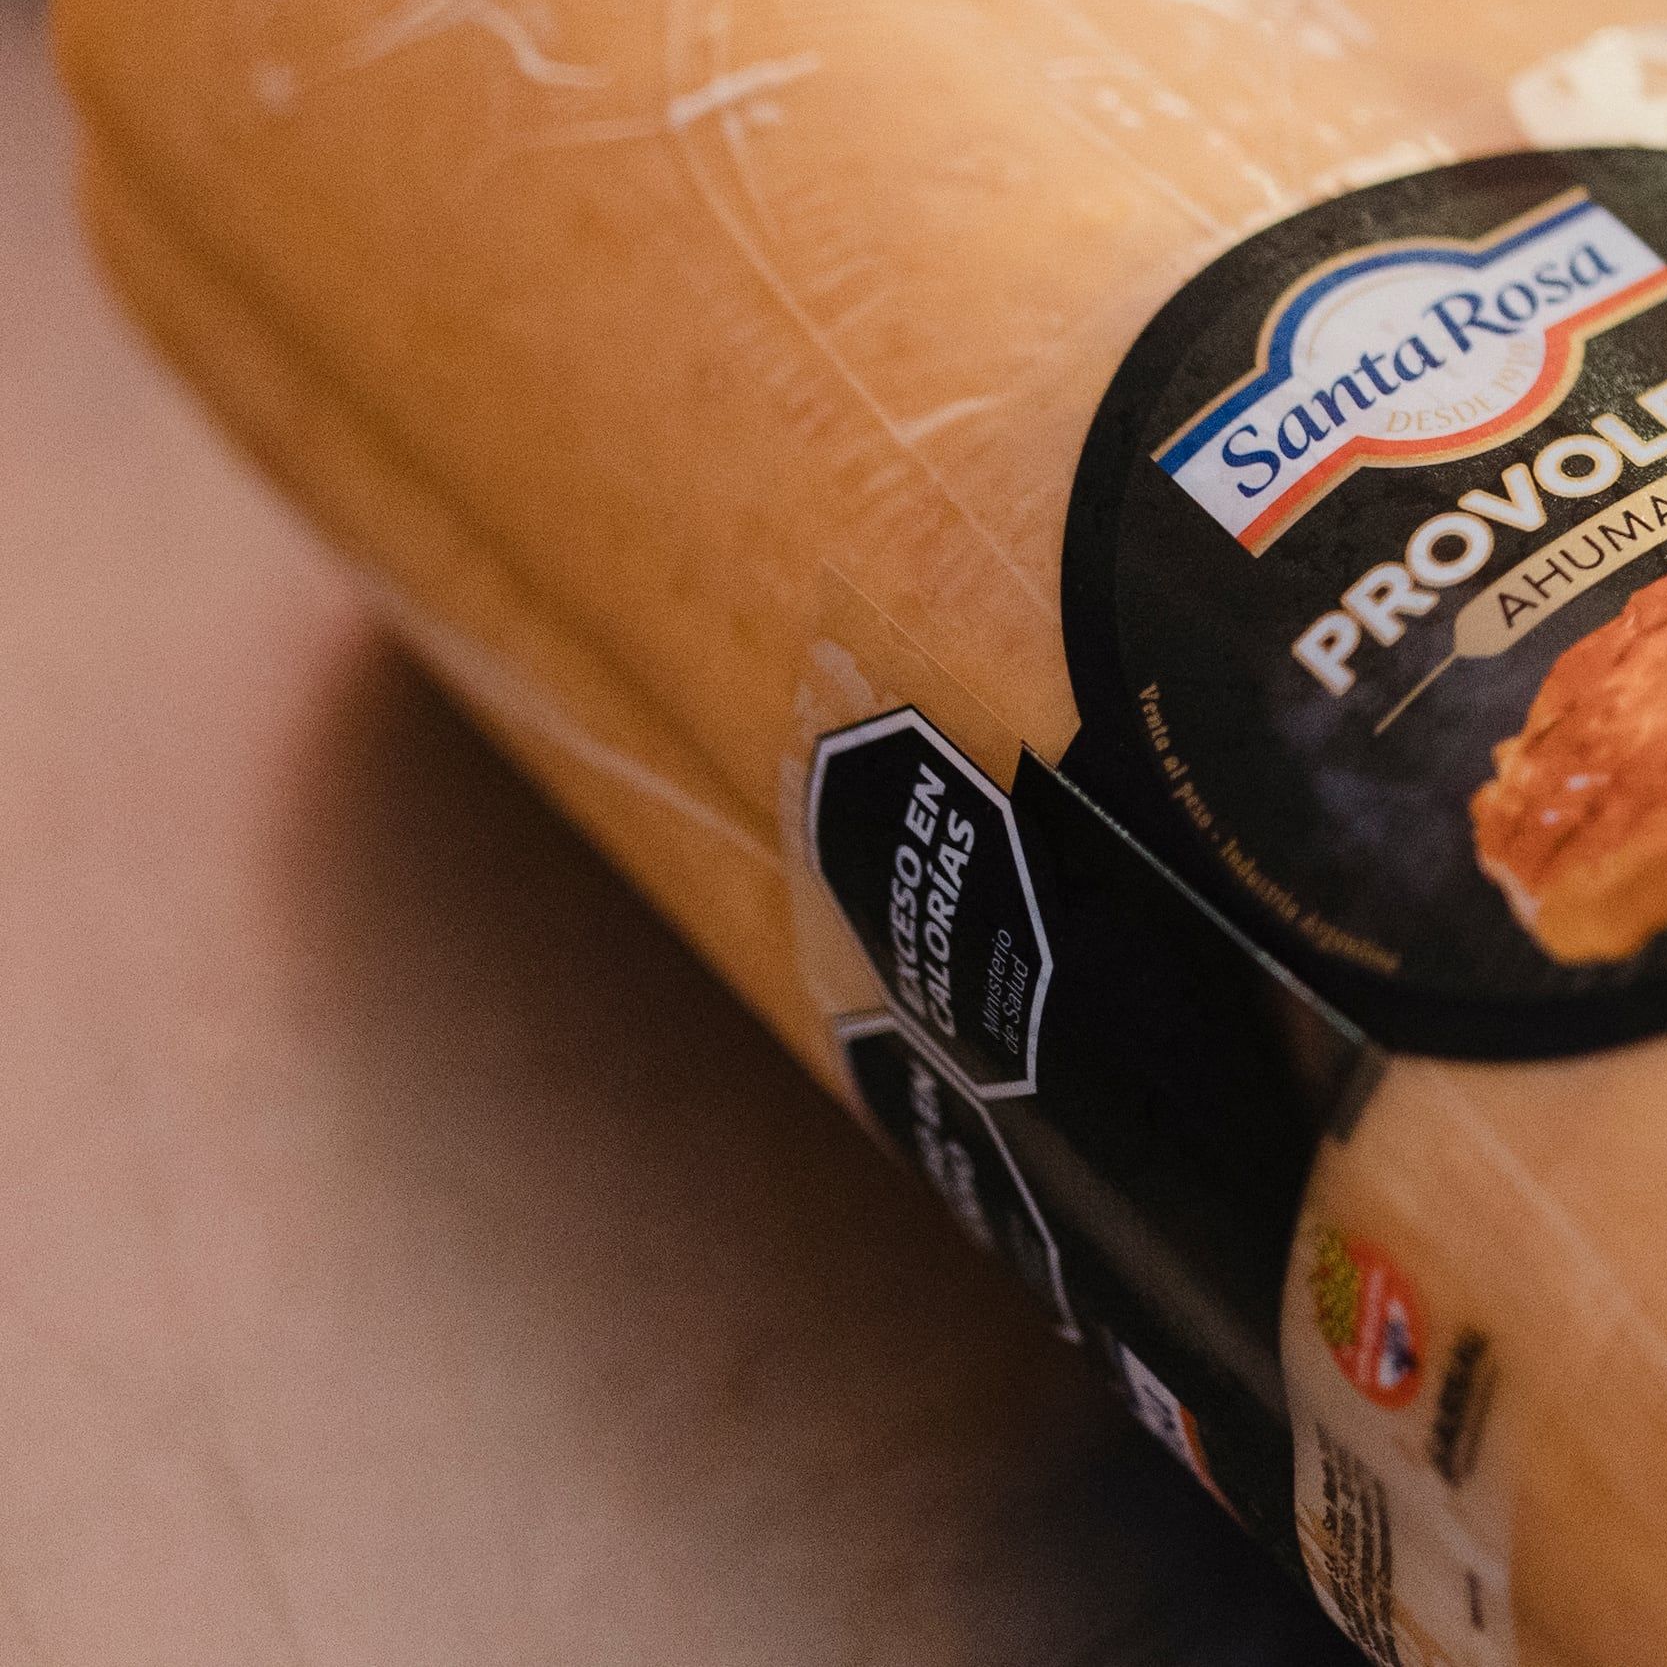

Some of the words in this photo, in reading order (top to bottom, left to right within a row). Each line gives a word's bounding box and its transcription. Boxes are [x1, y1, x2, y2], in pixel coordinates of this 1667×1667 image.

[1220, 334, 1445, 499] Santa
[1422, 239, 1622, 354] Rosa
[1387, 393, 1499, 433] DESDE
[1138, 681, 1170, 751] Venta
[904, 762, 946, 846] EN
[1162, 755, 1190, 780] al
[1172, 782, 1214, 828] peso
[1220, 838, 1300, 923] Industria
[889, 844, 928, 1021] EXCESO
[922, 808, 975, 1037] CALORÍAS
[983, 929, 1012, 1039] Ministerio
[1003, 953, 1029, 1025] Salud
[1002, 1021, 1019, 1055] de
